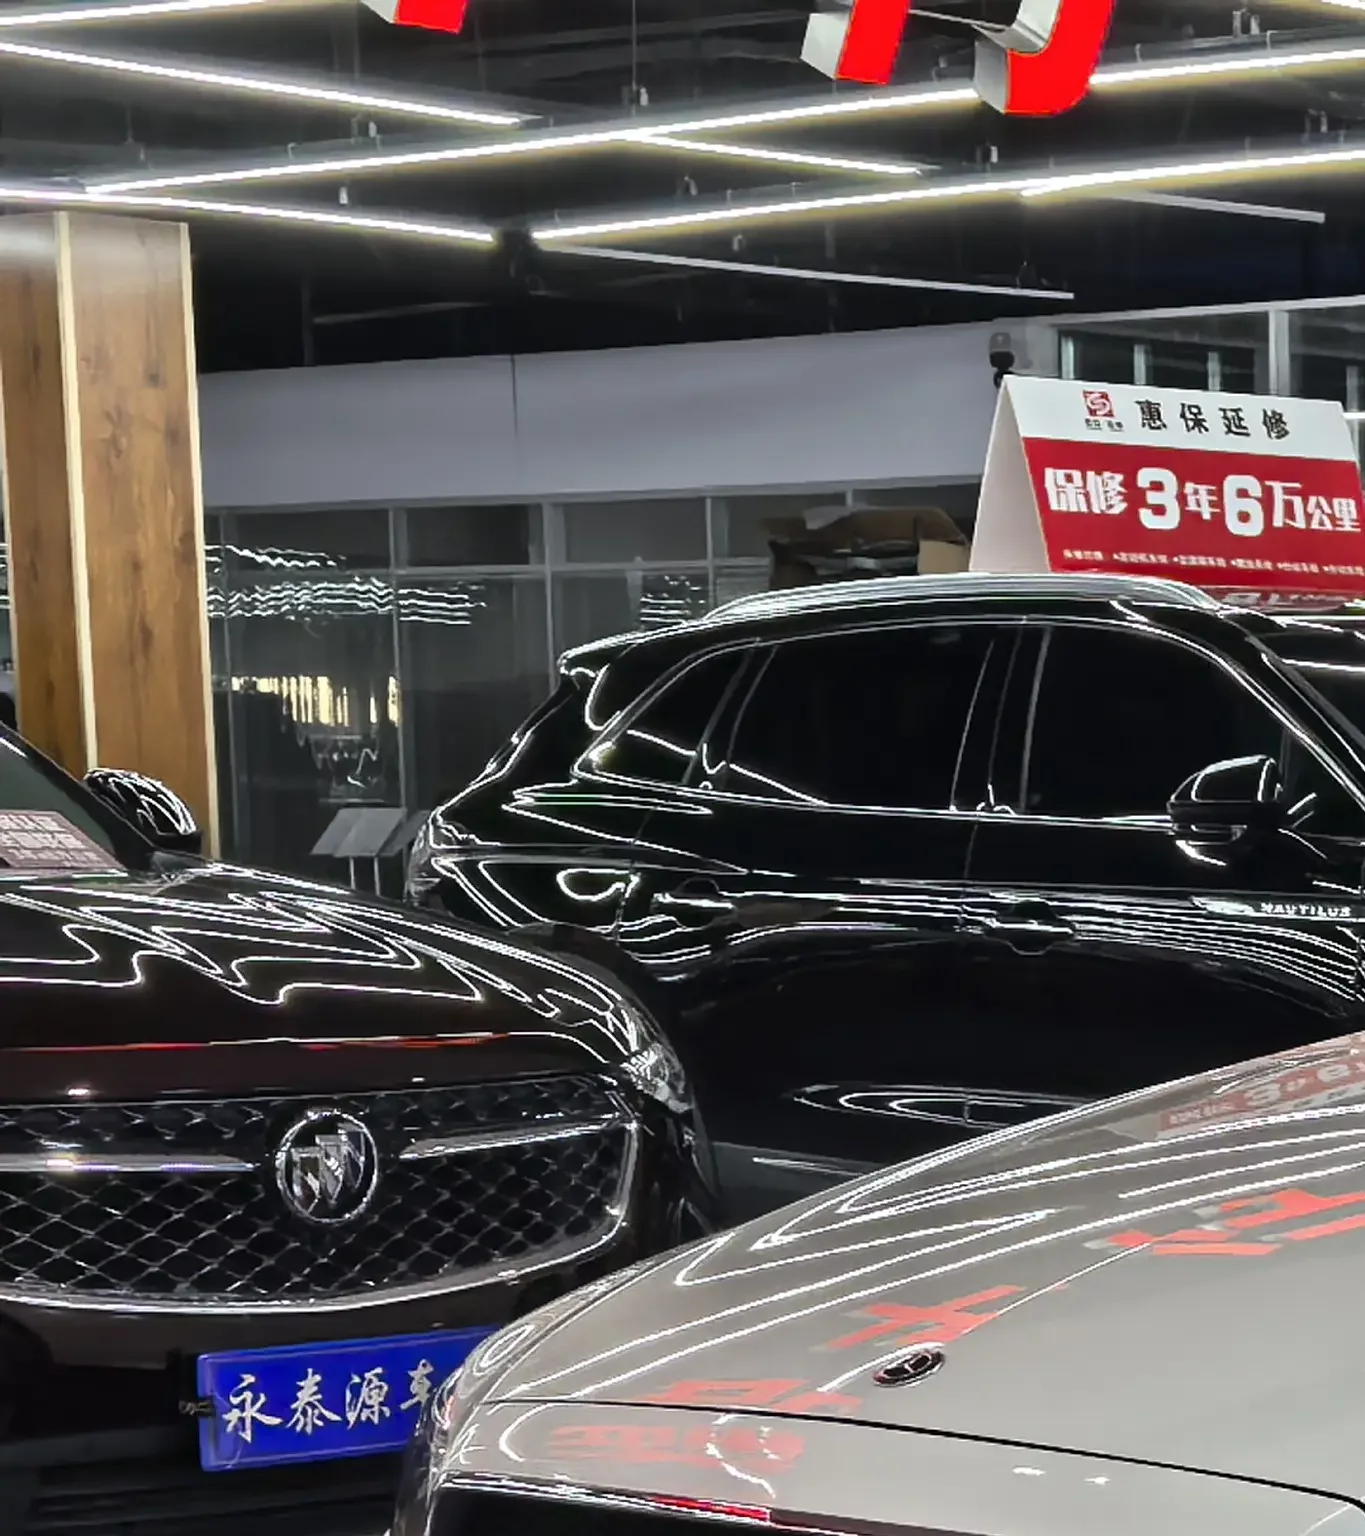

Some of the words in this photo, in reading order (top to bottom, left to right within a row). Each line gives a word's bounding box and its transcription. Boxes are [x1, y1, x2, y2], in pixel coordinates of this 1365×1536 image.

[1135, 398, 1291, 441] 惠保延修
[1043, 465, 1362, 538] 保修3年6万公里
[1260, 901, 1352, 918] NAUTILUS
